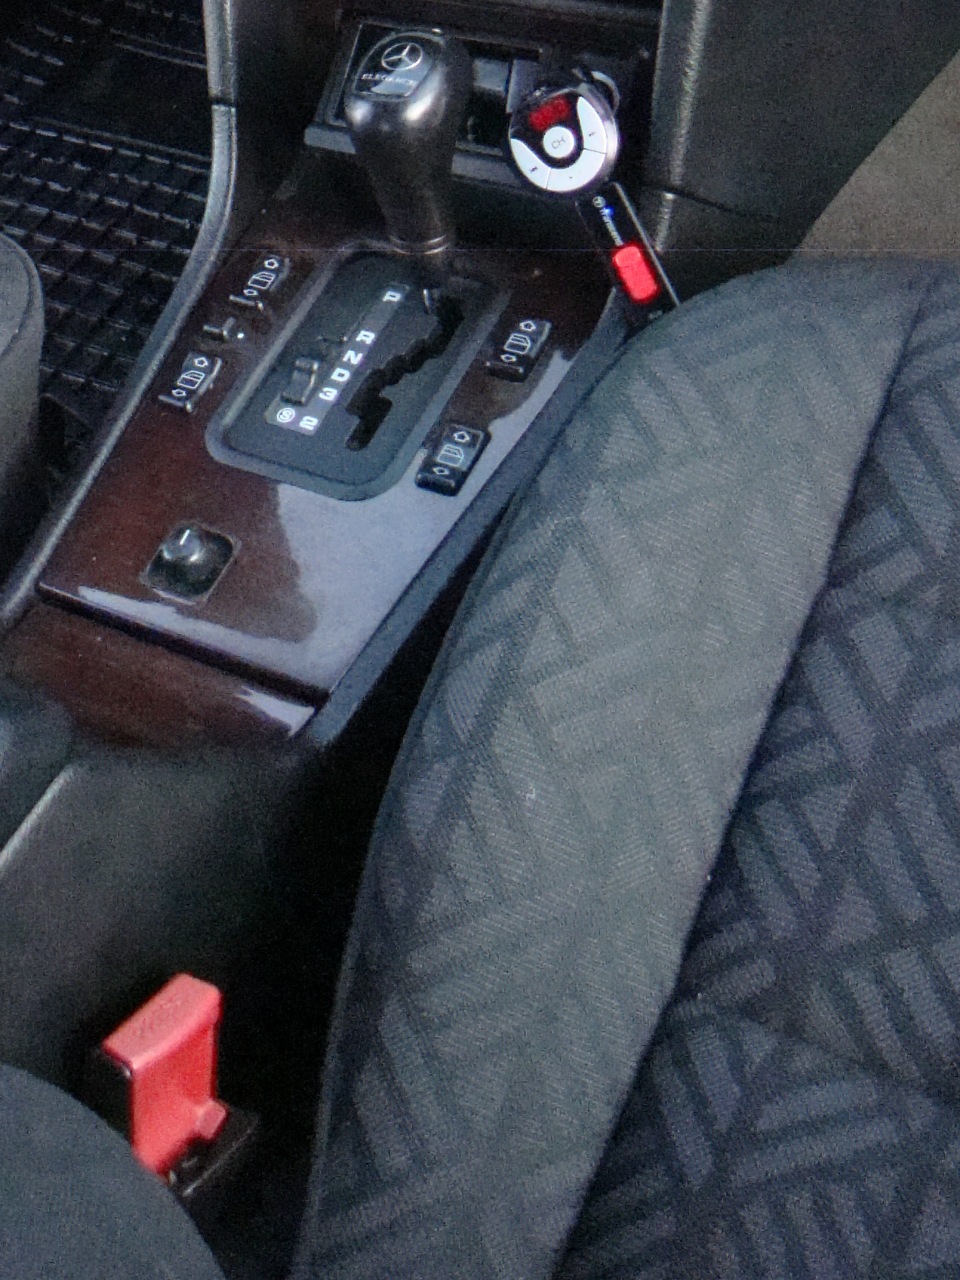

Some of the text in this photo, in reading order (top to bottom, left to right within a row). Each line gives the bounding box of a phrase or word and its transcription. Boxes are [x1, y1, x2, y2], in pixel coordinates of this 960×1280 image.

[551, 136, 566, 149] CH
[382, 290, 401, 302] P
[355, 330, 375, 345] R
[343, 350, 363, 365] N
[331, 367, 351, 382] D
[319, 387, 337, 401] 3
[299, 415, 318, 430] 2
